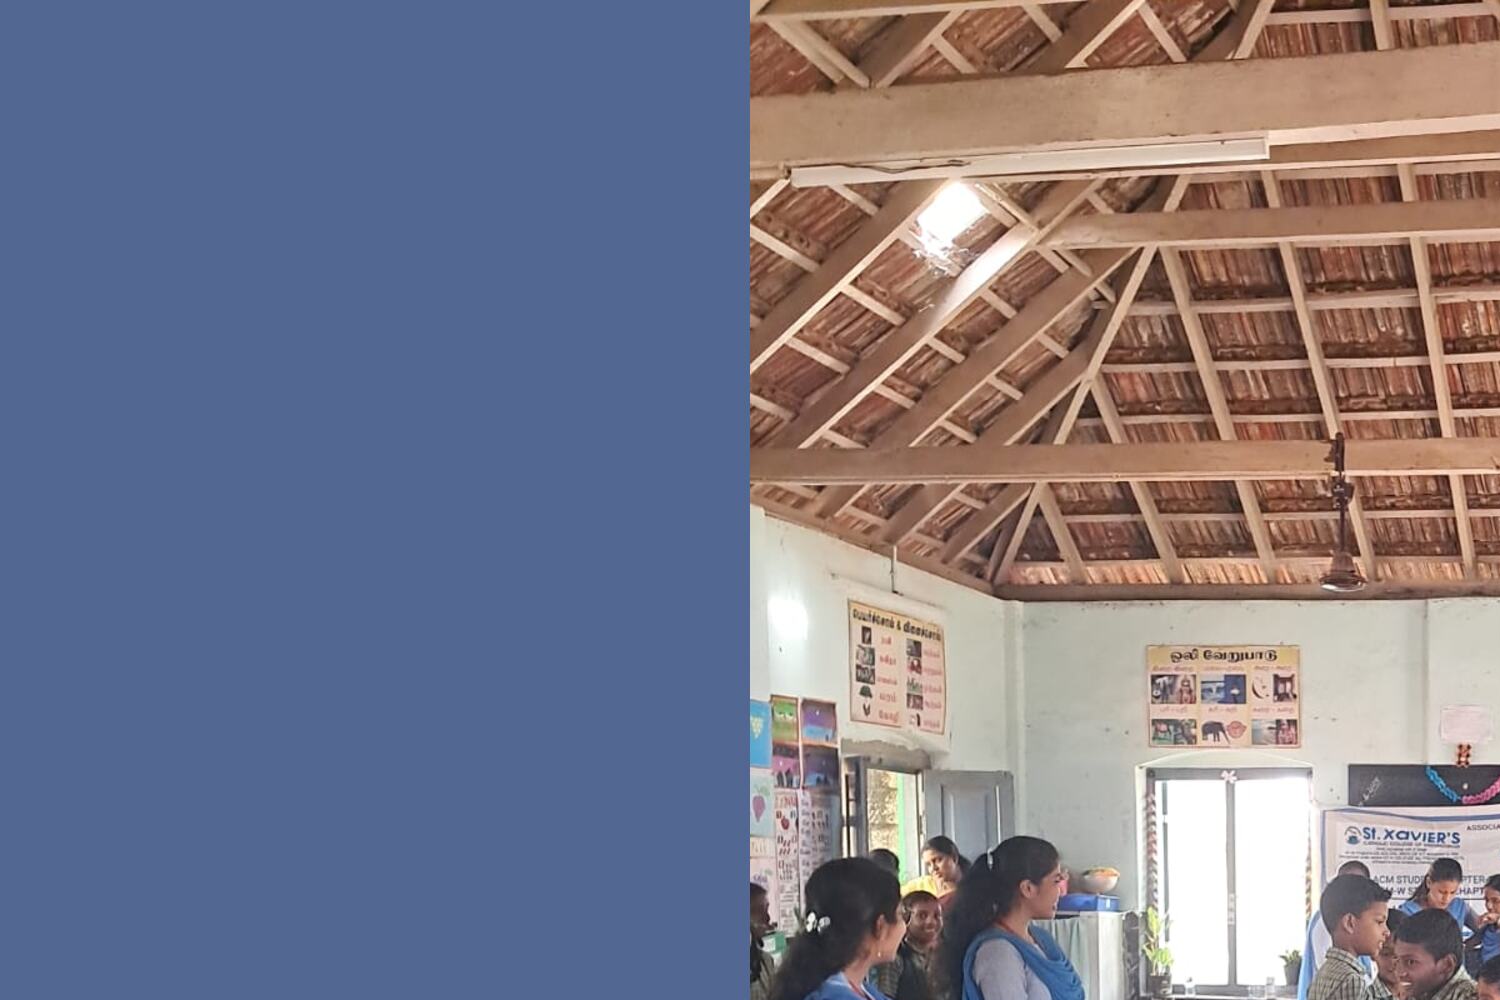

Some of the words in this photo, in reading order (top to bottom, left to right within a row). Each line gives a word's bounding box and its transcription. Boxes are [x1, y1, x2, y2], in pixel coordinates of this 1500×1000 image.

[1170, 648, 1199, 664] ஒலி
[1203, 649, 1278, 663] வேறுபாடு
[1363, 827, 1381, 840] St.
